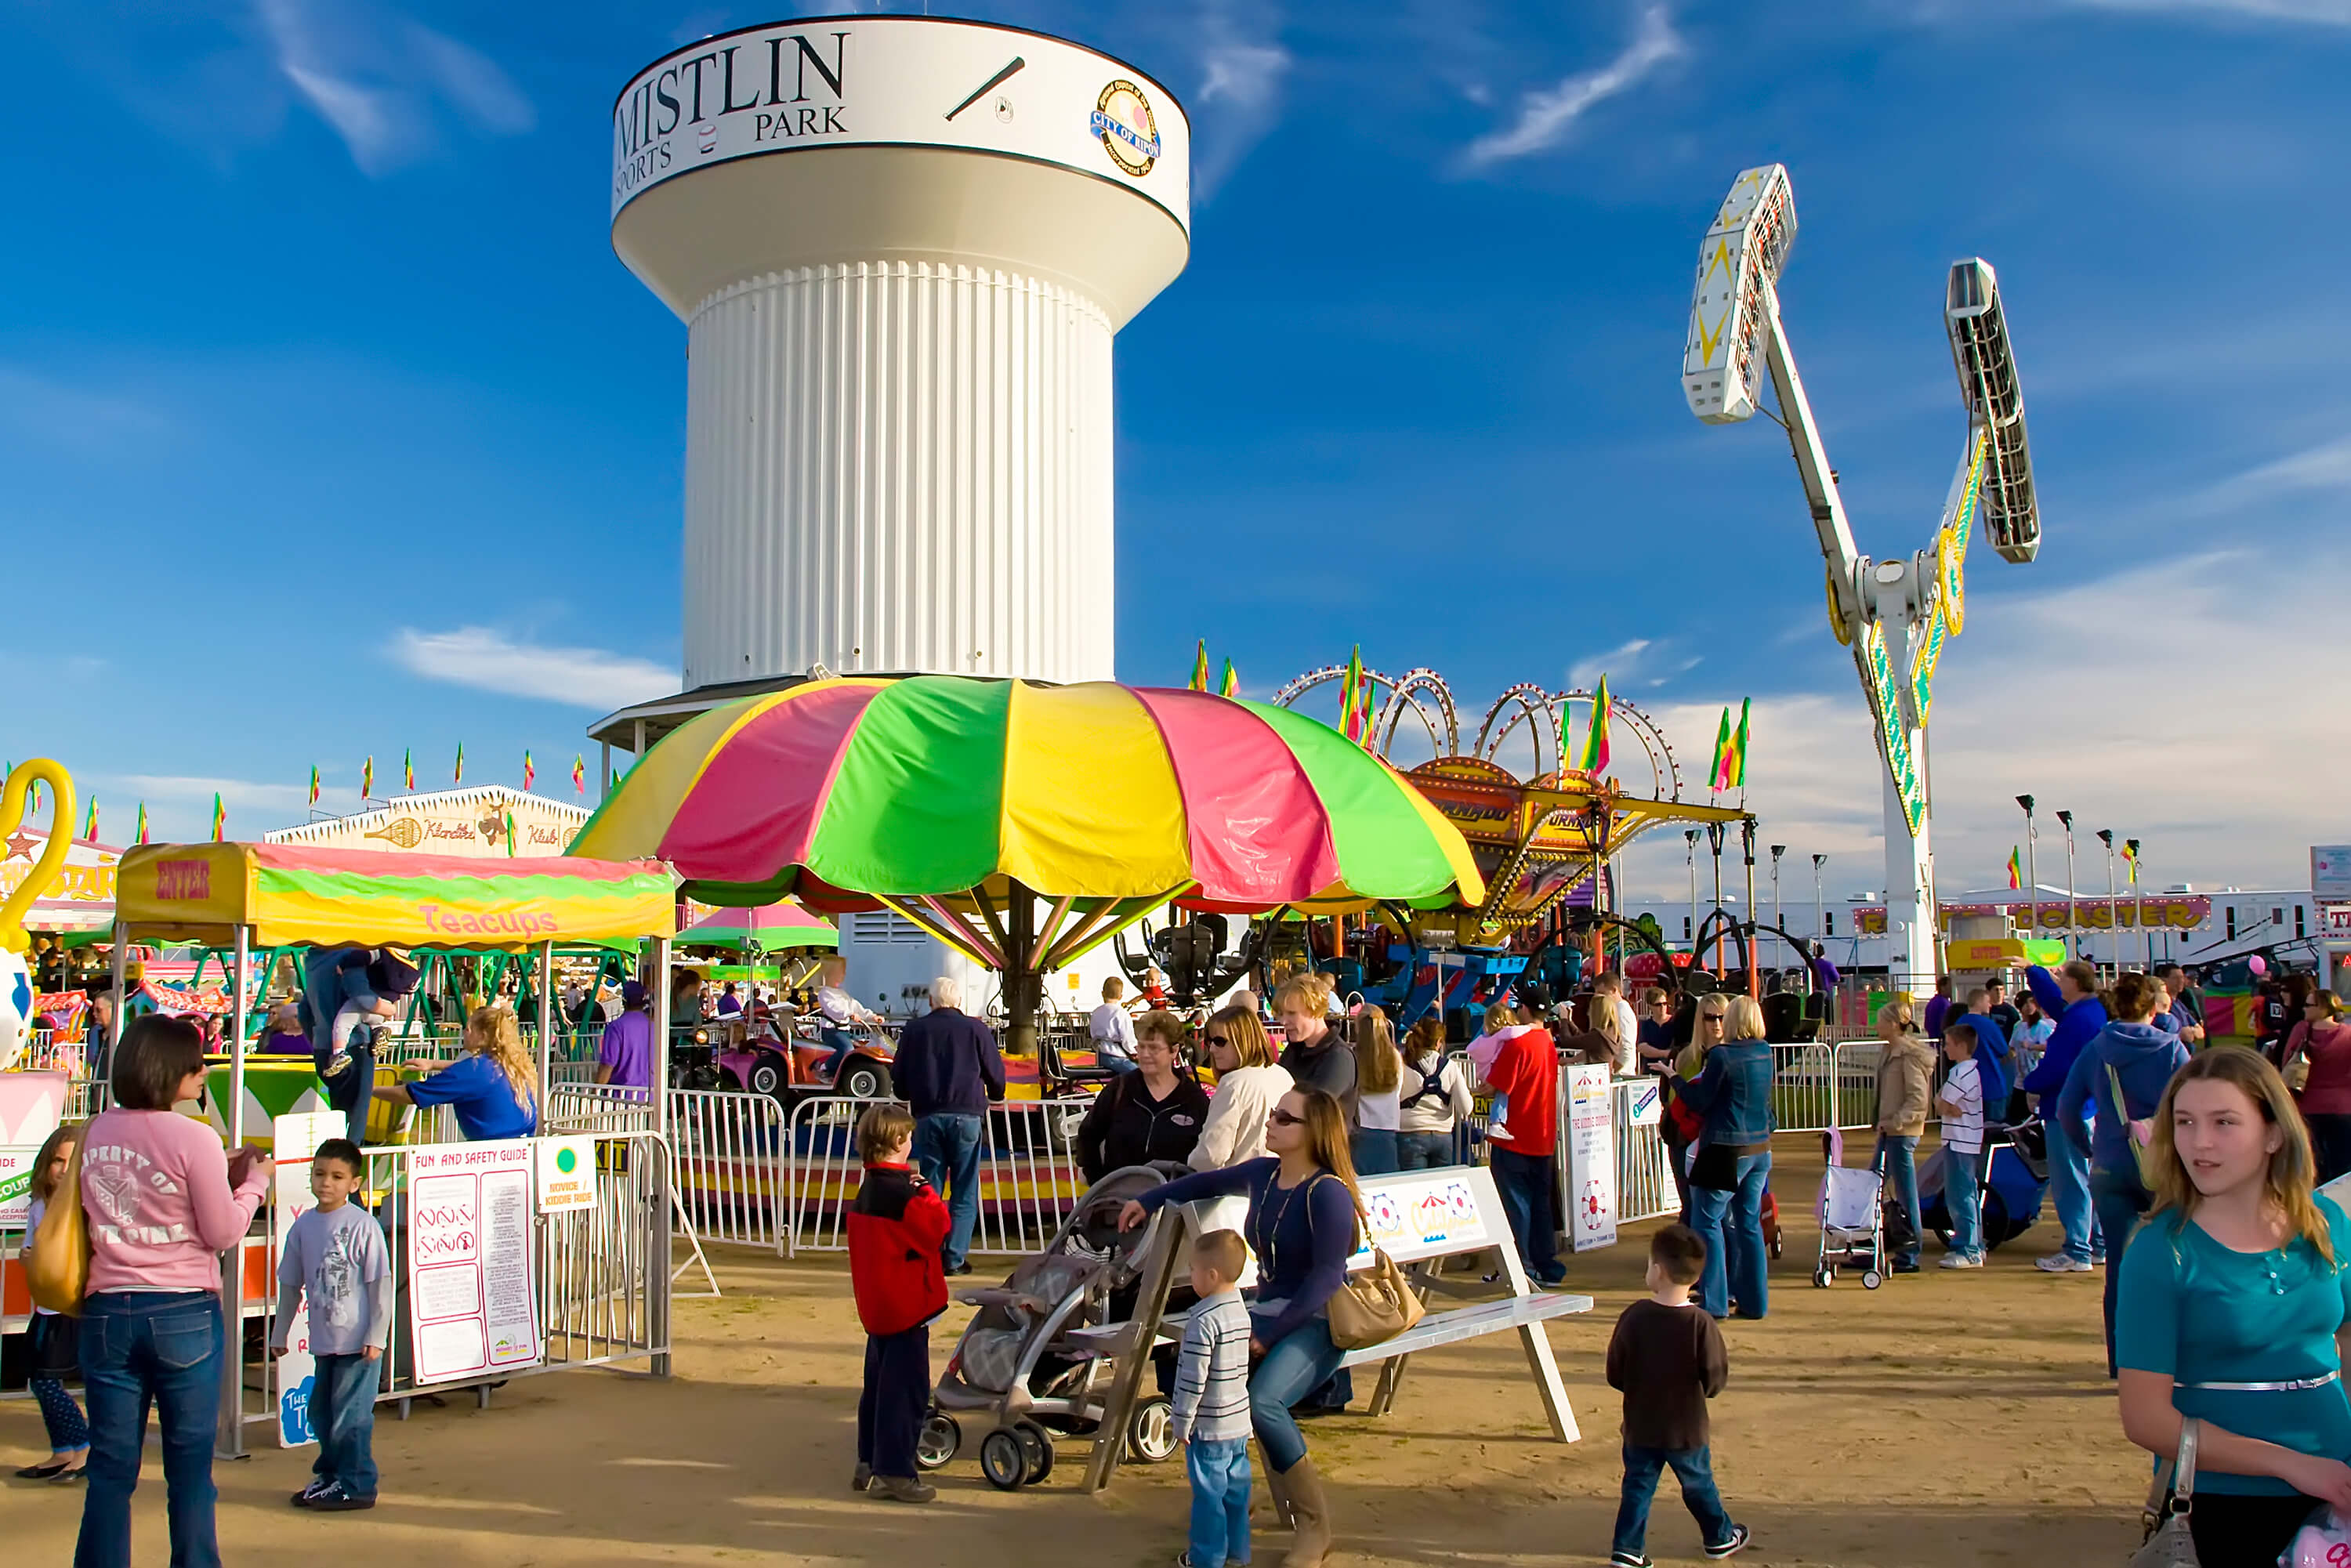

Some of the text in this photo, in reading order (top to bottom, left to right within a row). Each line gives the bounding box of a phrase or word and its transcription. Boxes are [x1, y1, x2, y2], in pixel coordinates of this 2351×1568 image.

[617, 32, 852, 170] MISTLIN
[753, 106, 849, 143] PARK
[1093, 111, 1159, 158] CITY OF RIPON
[614, 140, 672, 197] SPORTS
[527, 824, 559, 846] Klub
[156, 859, 210, 900] ENTER
[418, 905, 559, 940] Teacups
[2015, 904, 2202, 931] COASTER
[1474, 1097, 1494, 1114] ENT
[415, 1148, 527, 1168] FUN AND SAFETY GUIDE
[0, 1176, 31, 1199] OUP
[545, 1191, 592, 1206] KIDDIE RIDE
[549, 1181, 578, 1193] NOVICE
[286, 1392, 306, 1408] THE
